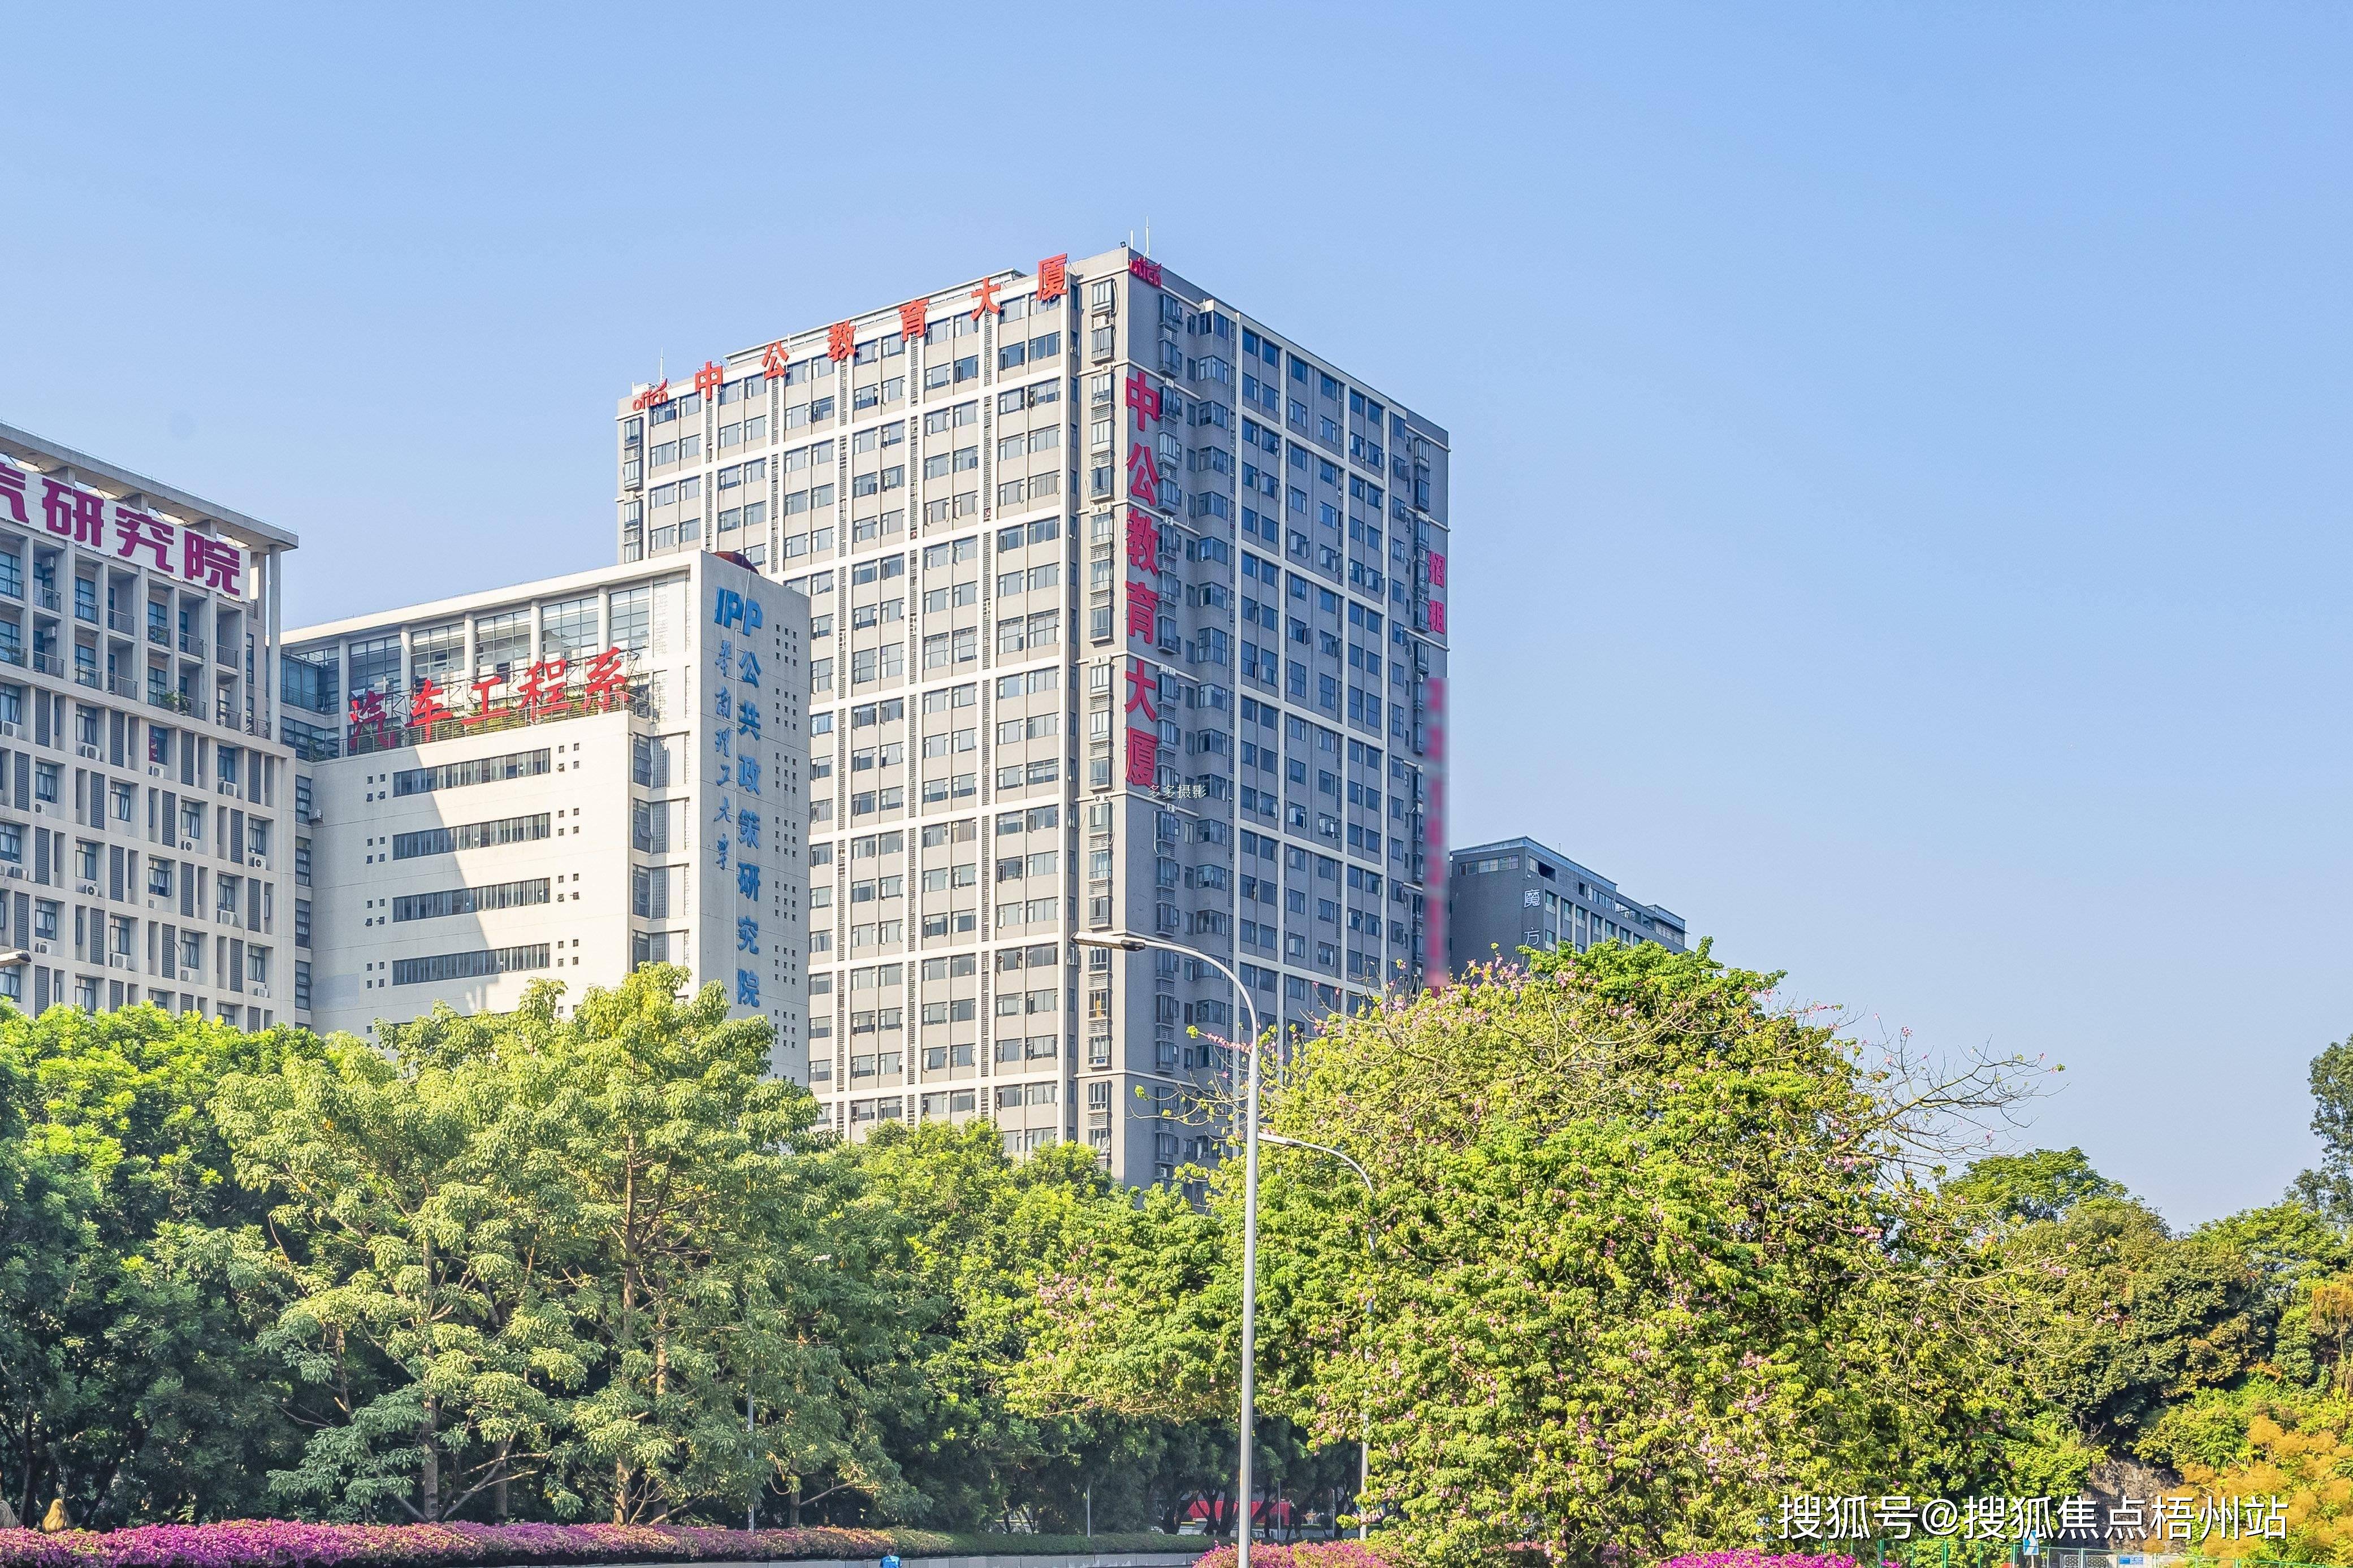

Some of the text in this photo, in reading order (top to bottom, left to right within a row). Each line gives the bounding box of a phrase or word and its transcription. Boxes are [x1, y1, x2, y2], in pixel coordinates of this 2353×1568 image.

[695, 253, 1069, 400] 中公教育大厦
[714, 586, 763, 637] IPP
[1124, 371, 1160, 790] 中公教育大厦
[1429, 550, 1446, 634] 招租
[349, 647, 629, 750] 汽车工程系
[737, 650, 763, 1007] 公共政策研究院
[1524, 889, 1540, 946] 魔方
